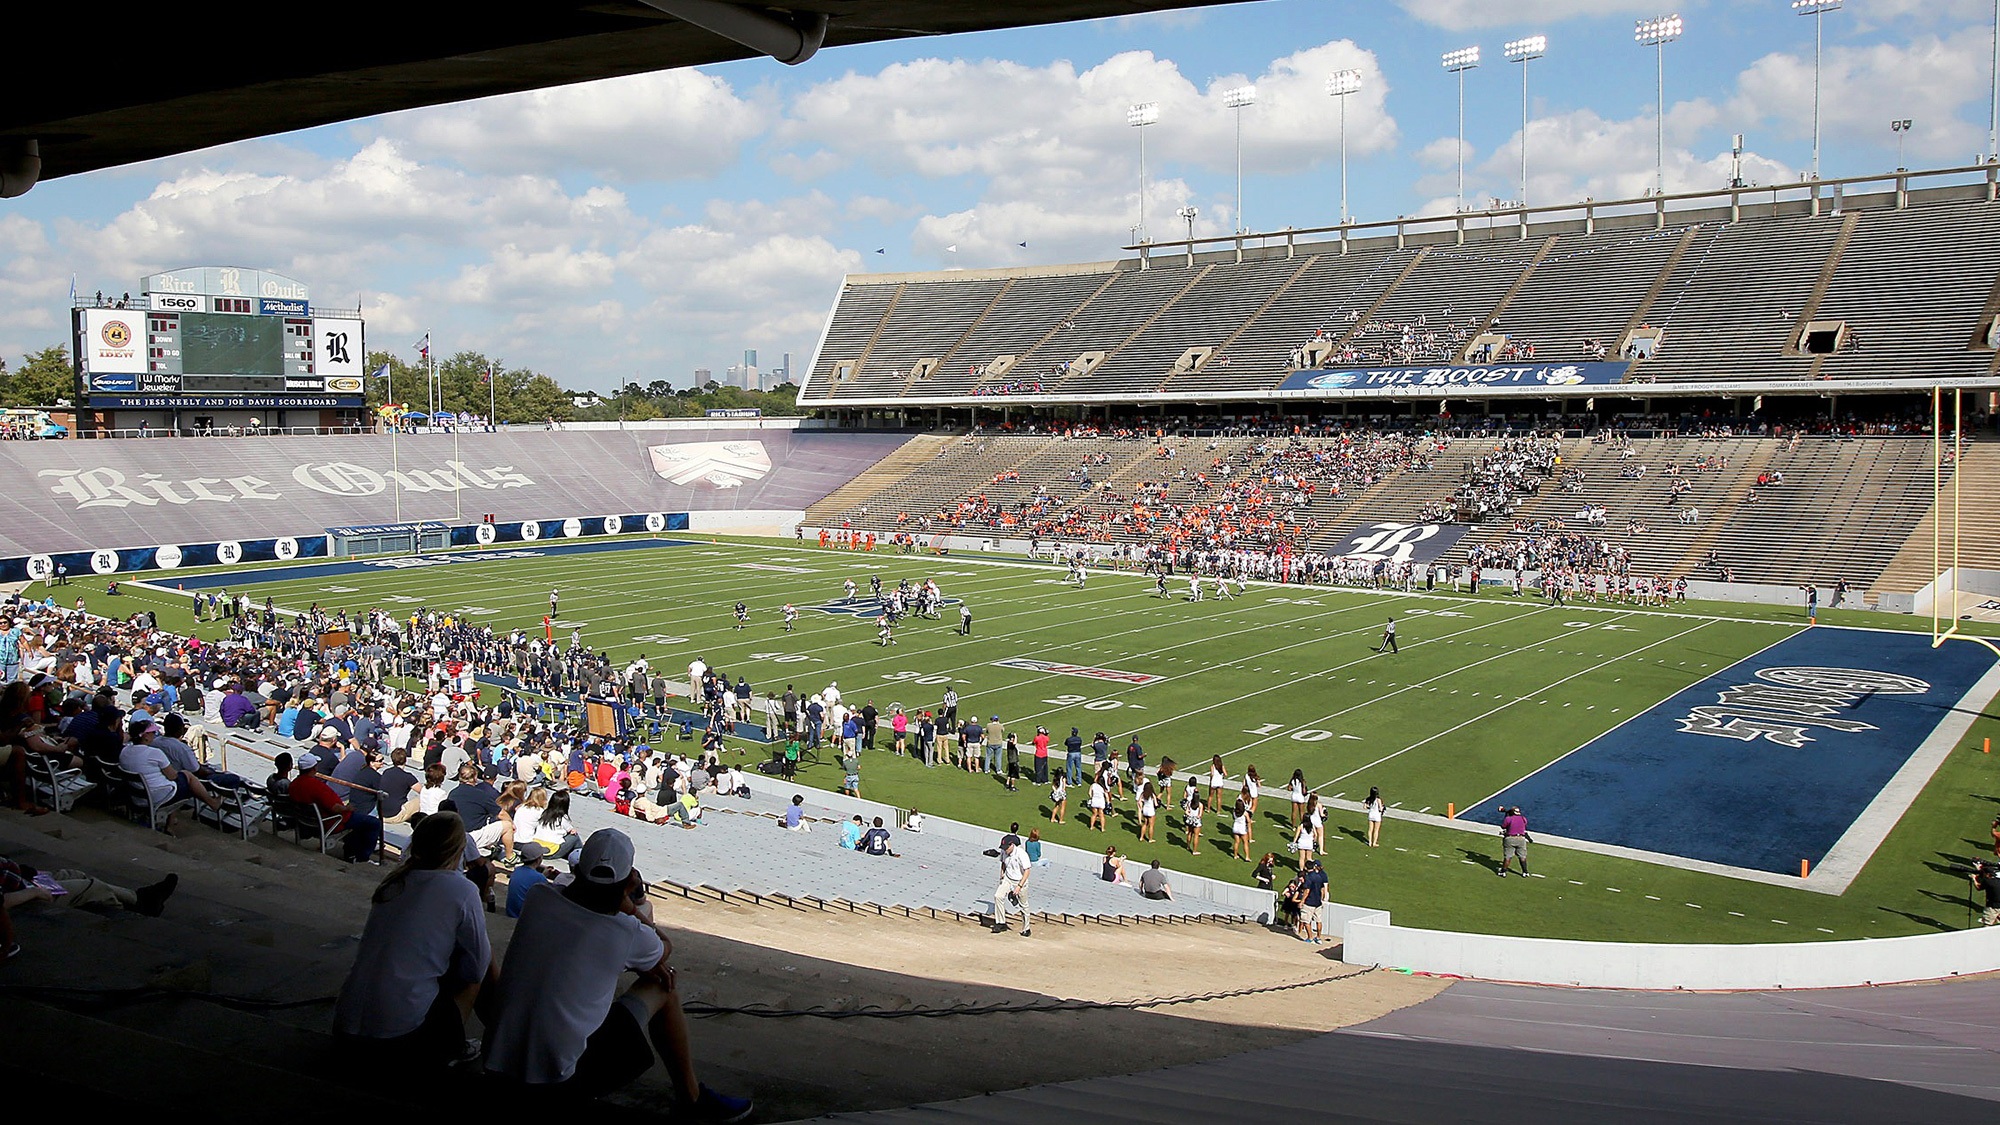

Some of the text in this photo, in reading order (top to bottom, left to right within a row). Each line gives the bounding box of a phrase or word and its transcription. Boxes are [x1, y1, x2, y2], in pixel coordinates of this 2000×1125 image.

[160, 274, 195, 293] Rice
[220, 268, 242, 295] R
[262, 280, 306, 299] Owls
[160, 298, 196, 308] 1560
[263, 301, 303, 311] Methodist
[325, 332, 351, 364] R
[1365, 367, 1533, 385] THE ROOST
[142, 383, 176, 391] Jewelers
[1325, 388, 1450, 396] UNIVERSITY
[37, 466, 282, 509] Rice
[292, 460, 536, 497] Owls
[1340, 522, 1440, 562] R
[748, 651, 812, 663] 40
[881, 671, 953, 685] 30
[1041, 694, 1124, 710] 20
[1243, 722, 1333, 742] 10
[873, 835, 882, 850] 2
